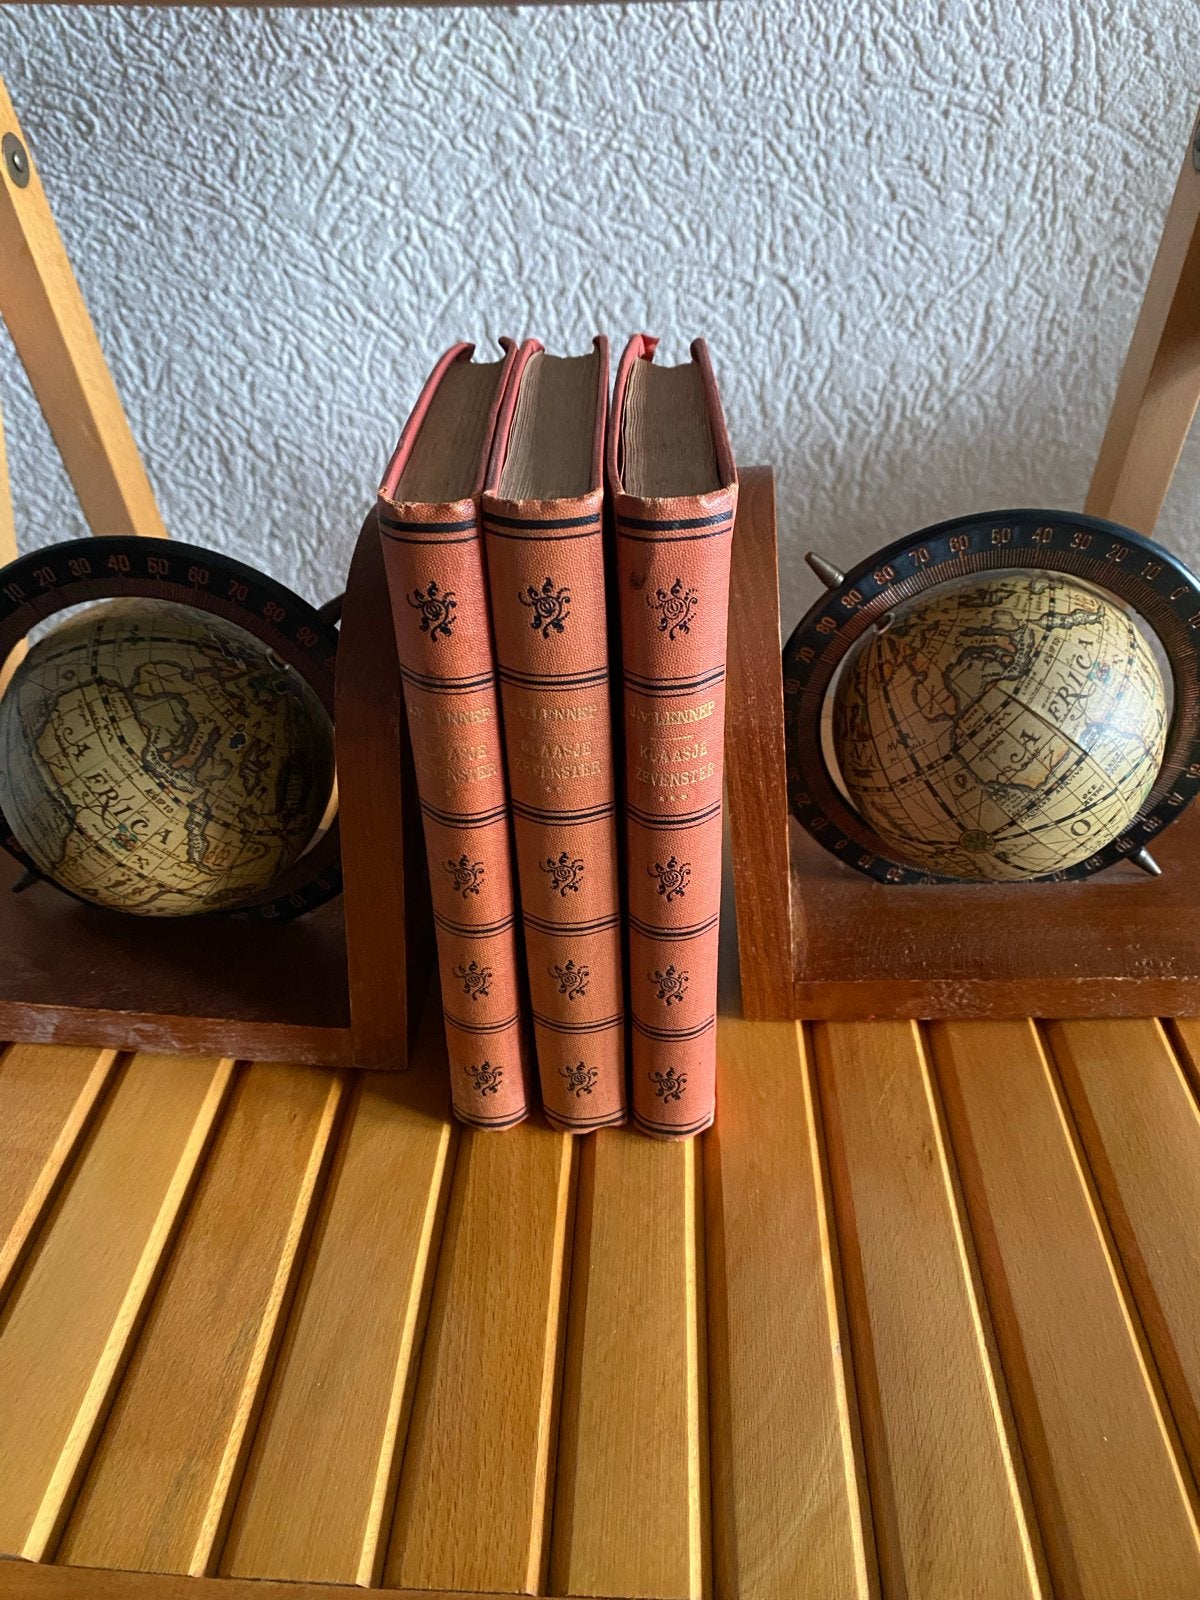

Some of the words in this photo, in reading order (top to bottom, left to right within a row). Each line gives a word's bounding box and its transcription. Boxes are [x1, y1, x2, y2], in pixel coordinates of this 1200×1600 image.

[907, 546, 932, 567] 70
[1031, 527, 1055, 544] 40
[1069, 531, 1094, 551] 30
[1105, 543, 1130, 563] 20
[1140, 561, 1163, 581] 10
[3, 582, 25, 601] 10
[33, 566, 57, 587] 20
[67, 556, 92, 577] 30
[106, 554, 131, 572] 40
[147, 556, 169, 576] 50
[188, 565, 209, 585] 60
[228, 579, 249, 600] 70
[263, 601, 286, 622] 80
[640, 740, 709, 764] KLAASJE
[635, 762, 715, 787] ZEVENSTER
